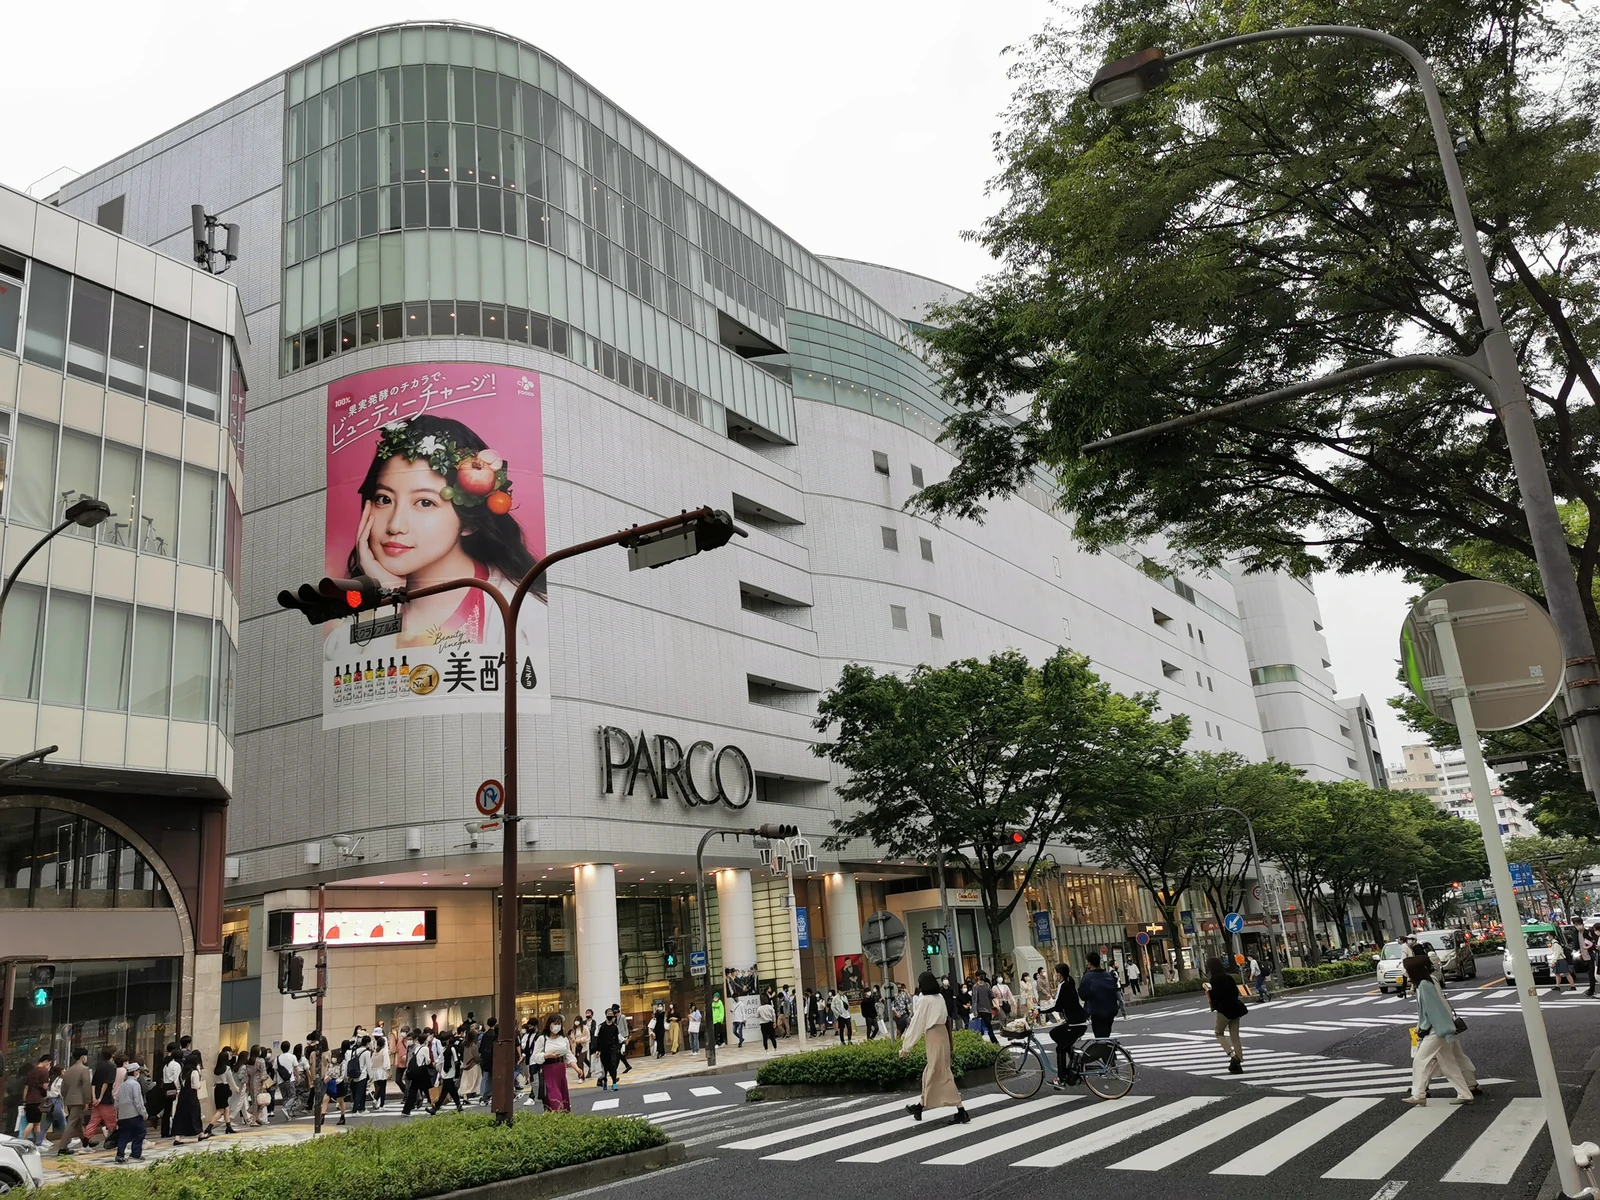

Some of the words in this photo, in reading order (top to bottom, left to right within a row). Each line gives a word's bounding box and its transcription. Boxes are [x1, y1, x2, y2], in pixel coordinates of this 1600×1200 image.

[517, 389, 535, 397] FOODS
[335, 396, 351, 408] 100%
[433, 630, 466, 646] Beauty
[438, 639, 474, 654] Vinegar
[412, 674, 434, 689] No.1
[598, 725, 756, 810] PARCO
